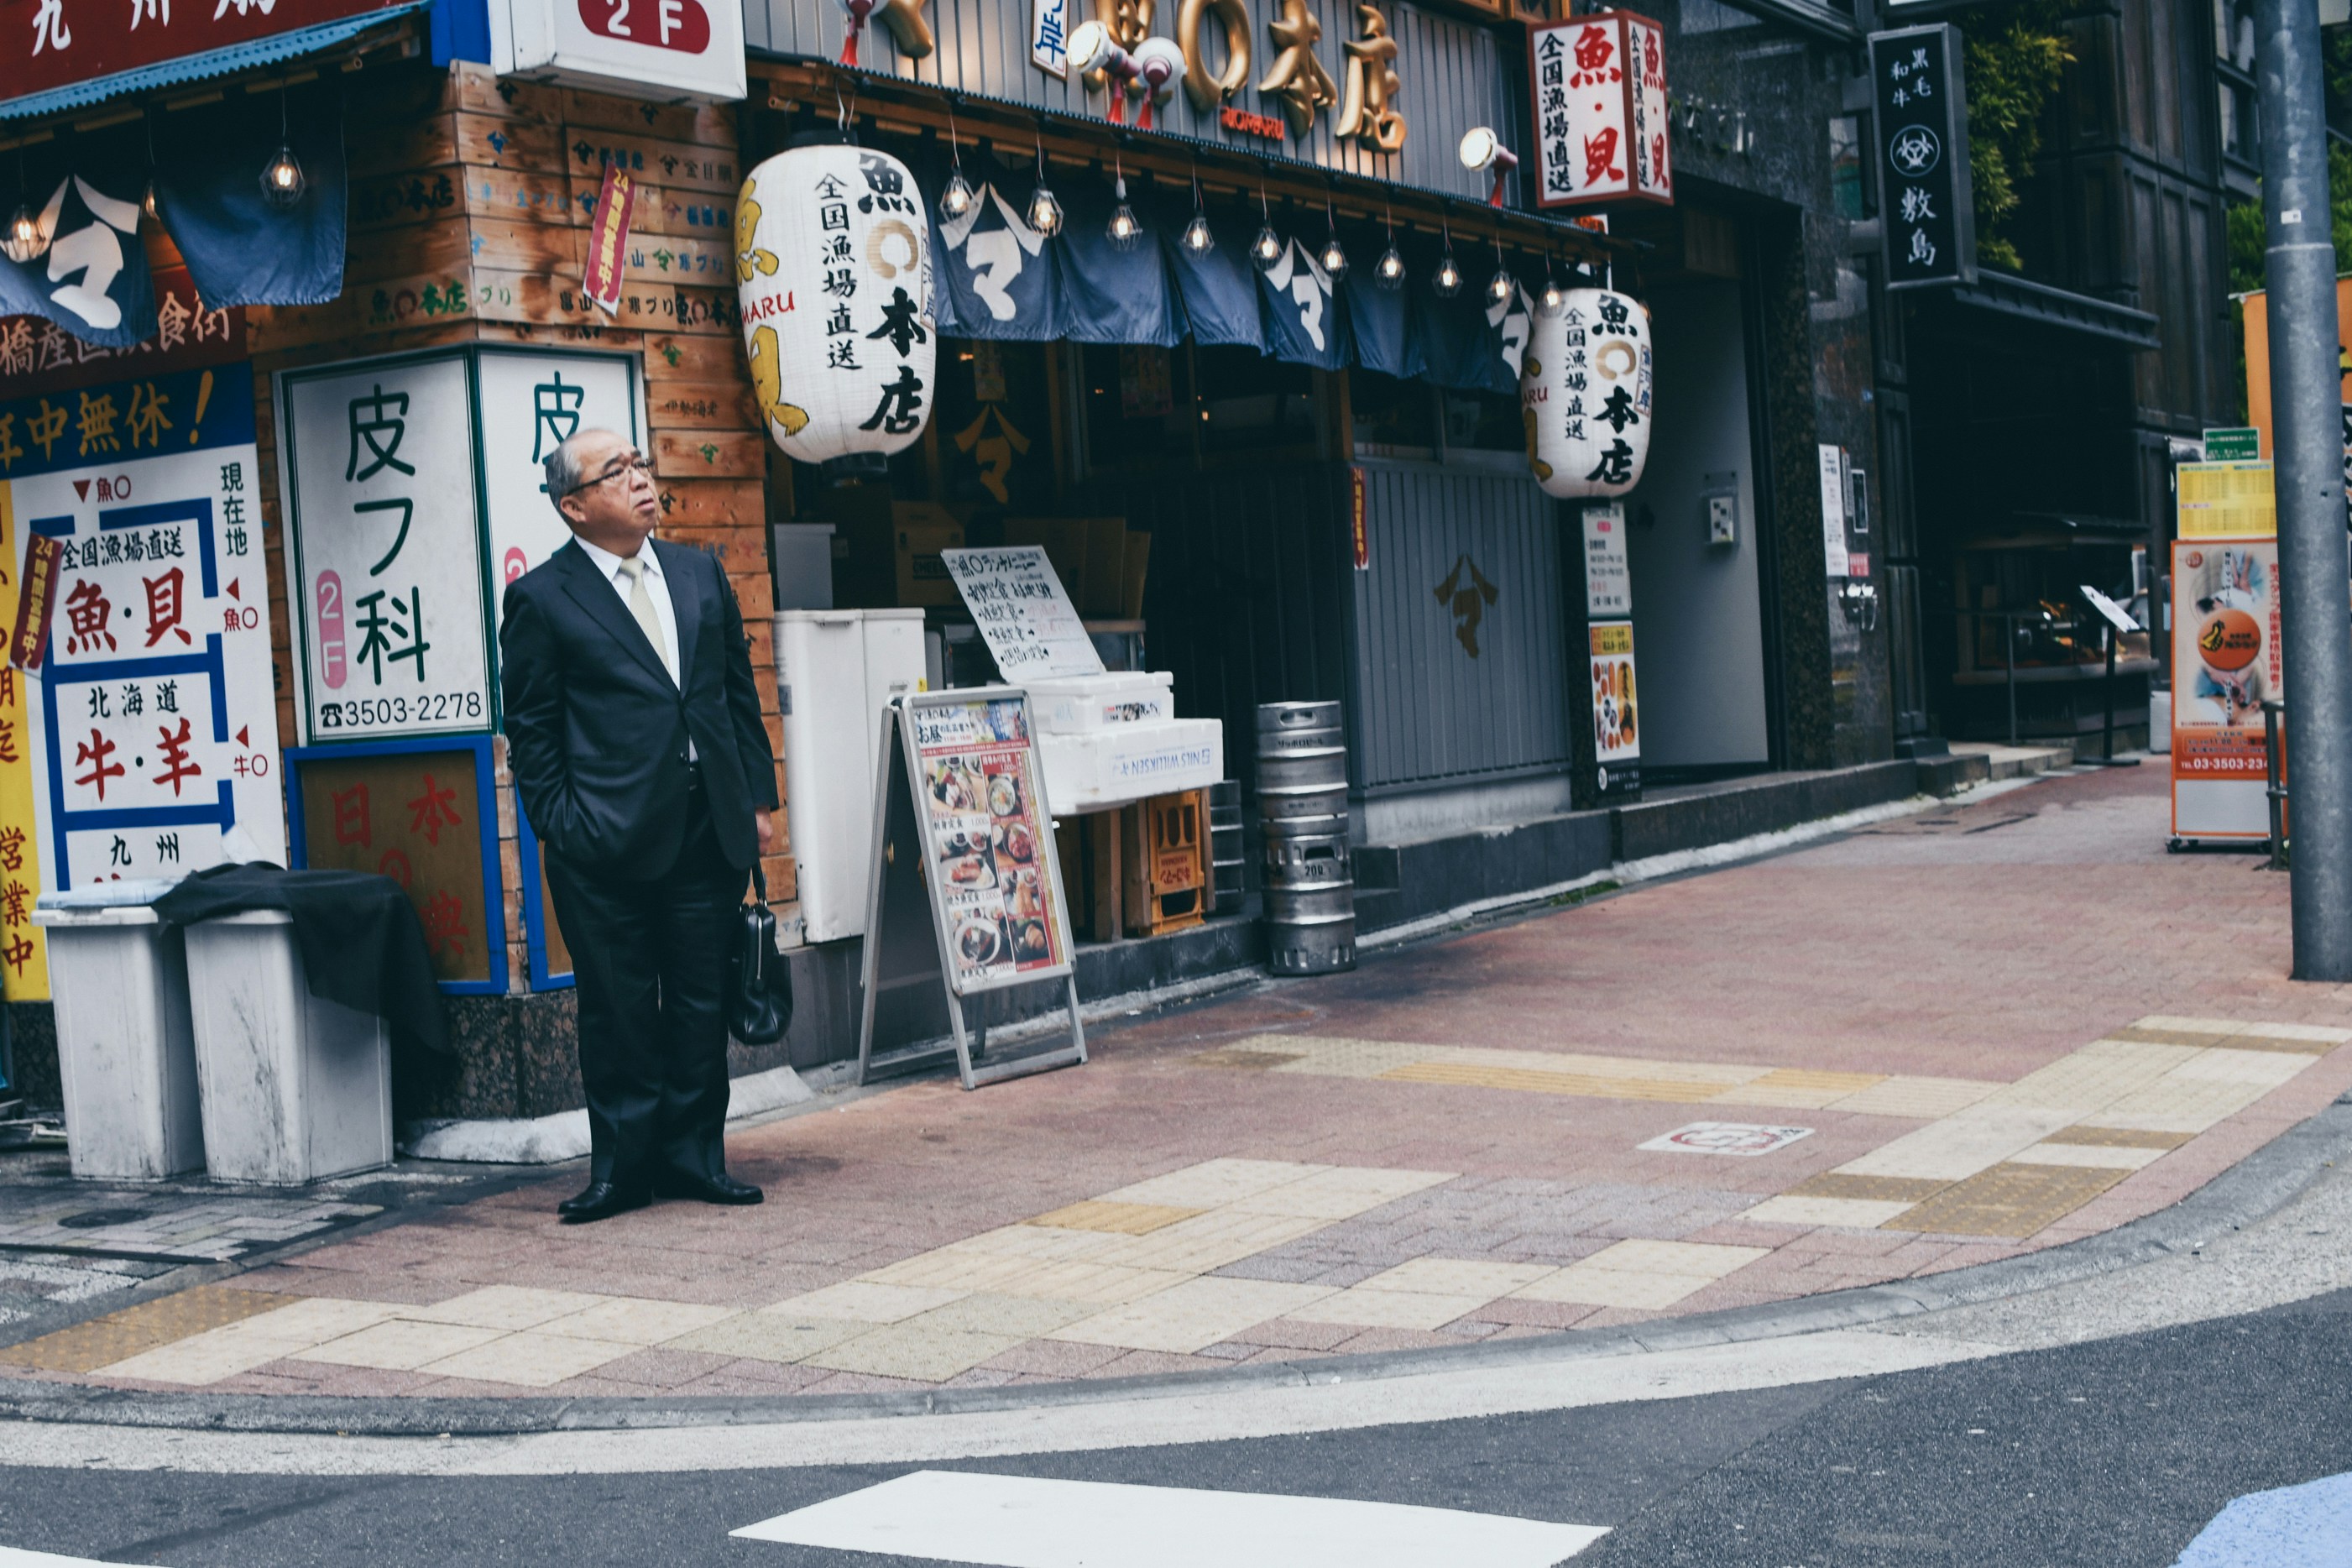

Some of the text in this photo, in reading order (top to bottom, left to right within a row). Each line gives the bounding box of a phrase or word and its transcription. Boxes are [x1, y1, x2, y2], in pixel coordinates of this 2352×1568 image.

[1539, 32, 1573, 192] 全国漁場直送
[814, 173, 863, 370] 全国漁場直送
[1900, 186, 1936, 266] 敷島
[1564, 307, 1589, 442] 全国漁場直送
[61, 526, 185, 572] 全国漁場直送
[220, 463, 248, 557] 現在地
[345, 383, 431, 686] 皮フ科
[320, 581, 344, 680] 2F
[88, 682, 180, 718] 北海道
[345, 691, 482, 726] 3503-2278
[110, 832, 180, 866] 九州
